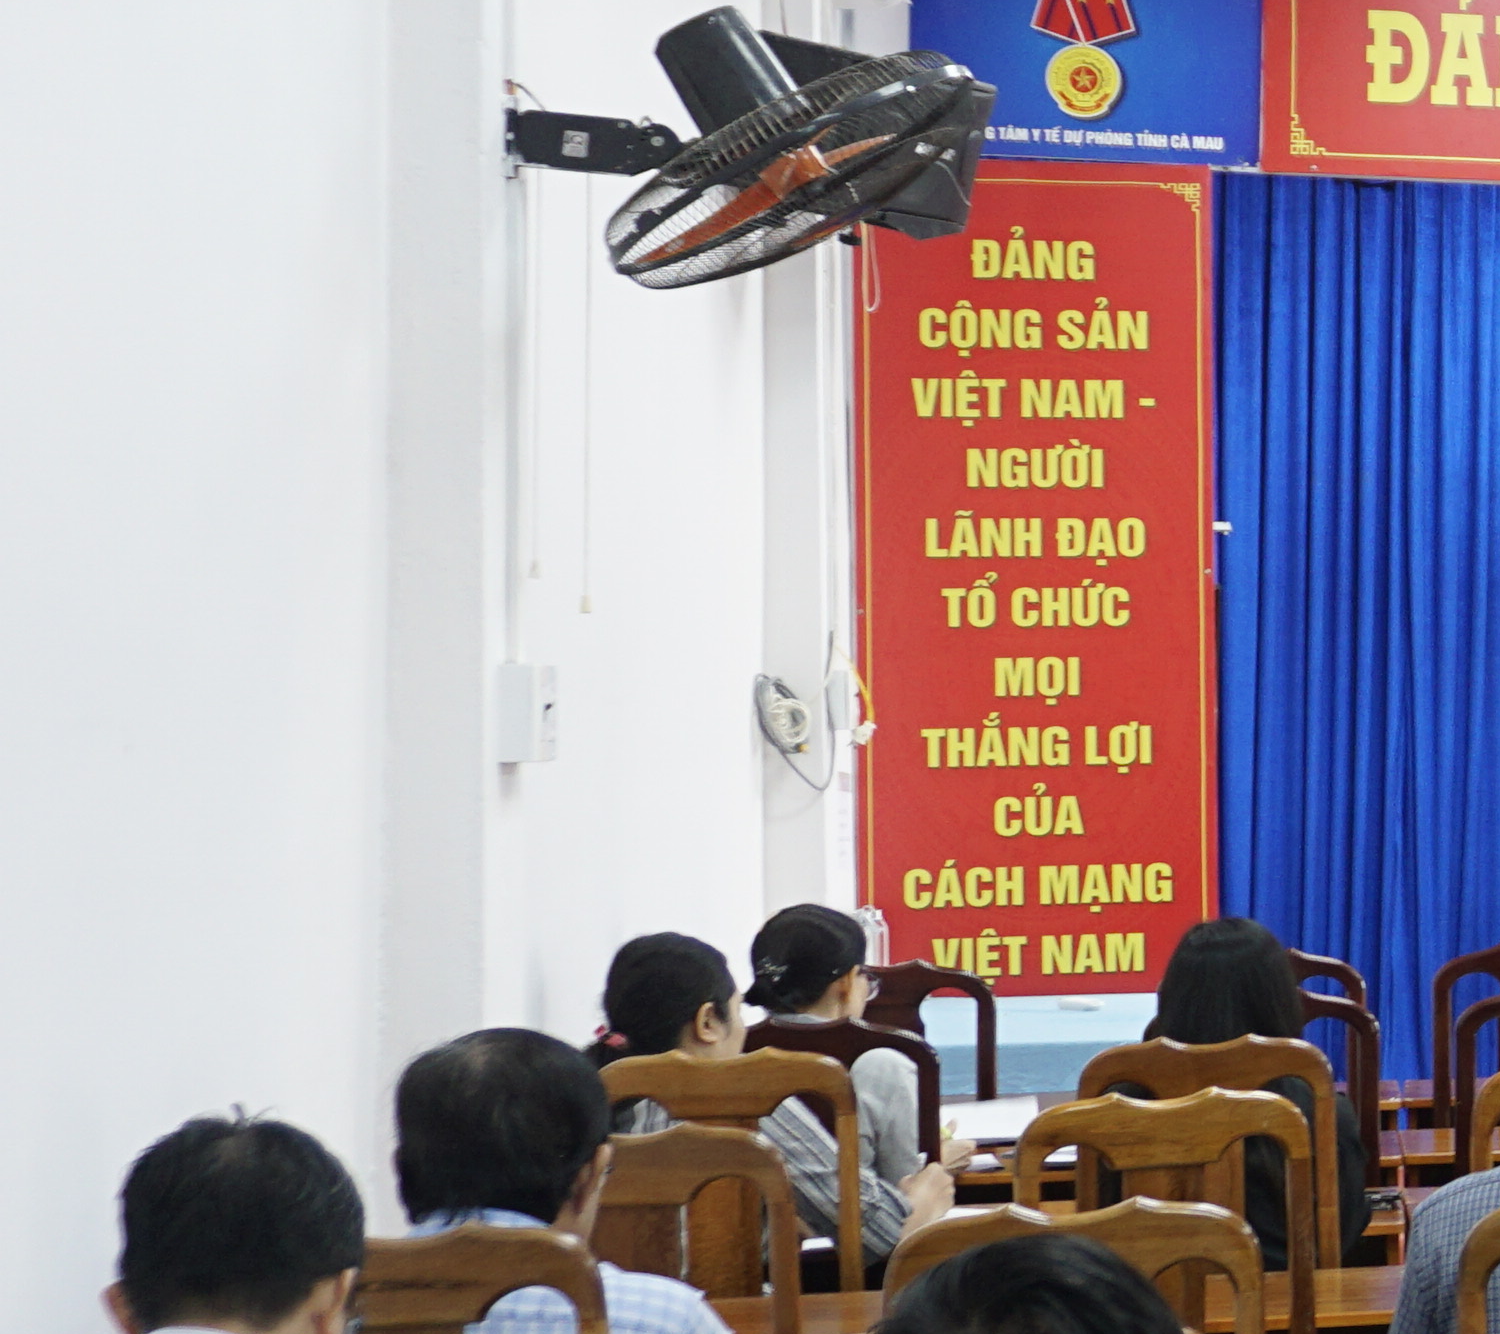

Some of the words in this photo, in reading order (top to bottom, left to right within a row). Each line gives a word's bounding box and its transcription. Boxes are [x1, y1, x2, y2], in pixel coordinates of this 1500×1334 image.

[998, 124, 1029, 141] TÂM
[1031, 129, 1041, 142] Y
[1044, 126, 1062, 143] TẾ
[1063, 129, 1085, 147] DỰ
[1086, 128, 1134, 147] PHÒNG
[1136, 129, 1169, 149] TỈNH
[1170, 132, 1191, 149] CÀ
[1192, 136, 1225, 151] MAU
[971, 226, 1096, 282] ĐẢNG
[919, 299, 1042, 358] CỘNG
[1057, 296, 1149, 351] SẢN
[911, 369, 1007, 427] VIỆT
[1020, 378, 1125, 420] NAM
[1138, 397, 1156, 407] -
[966, 438, 1105, 490] NGƯỜI
[925, 509, 1043, 559] LÃNH
[1055, 517, 1147, 567] ĐẠO
[941, 571, 998, 628] TỔ
[1011, 578, 1131, 628] CHỨC
[994, 656, 1081, 707] MỌI
[920, 711, 1070, 768] THẮNG
[1084, 720, 1152, 774] LỢI
[993, 782, 1085, 837] CỦA
[903, 859, 1025, 910] CÁCH
[1039, 862, 1174, 913] MẠNG
[931, 928, 1028, 986] VIỆT
[1041, 932, 1145, 975] NAM
